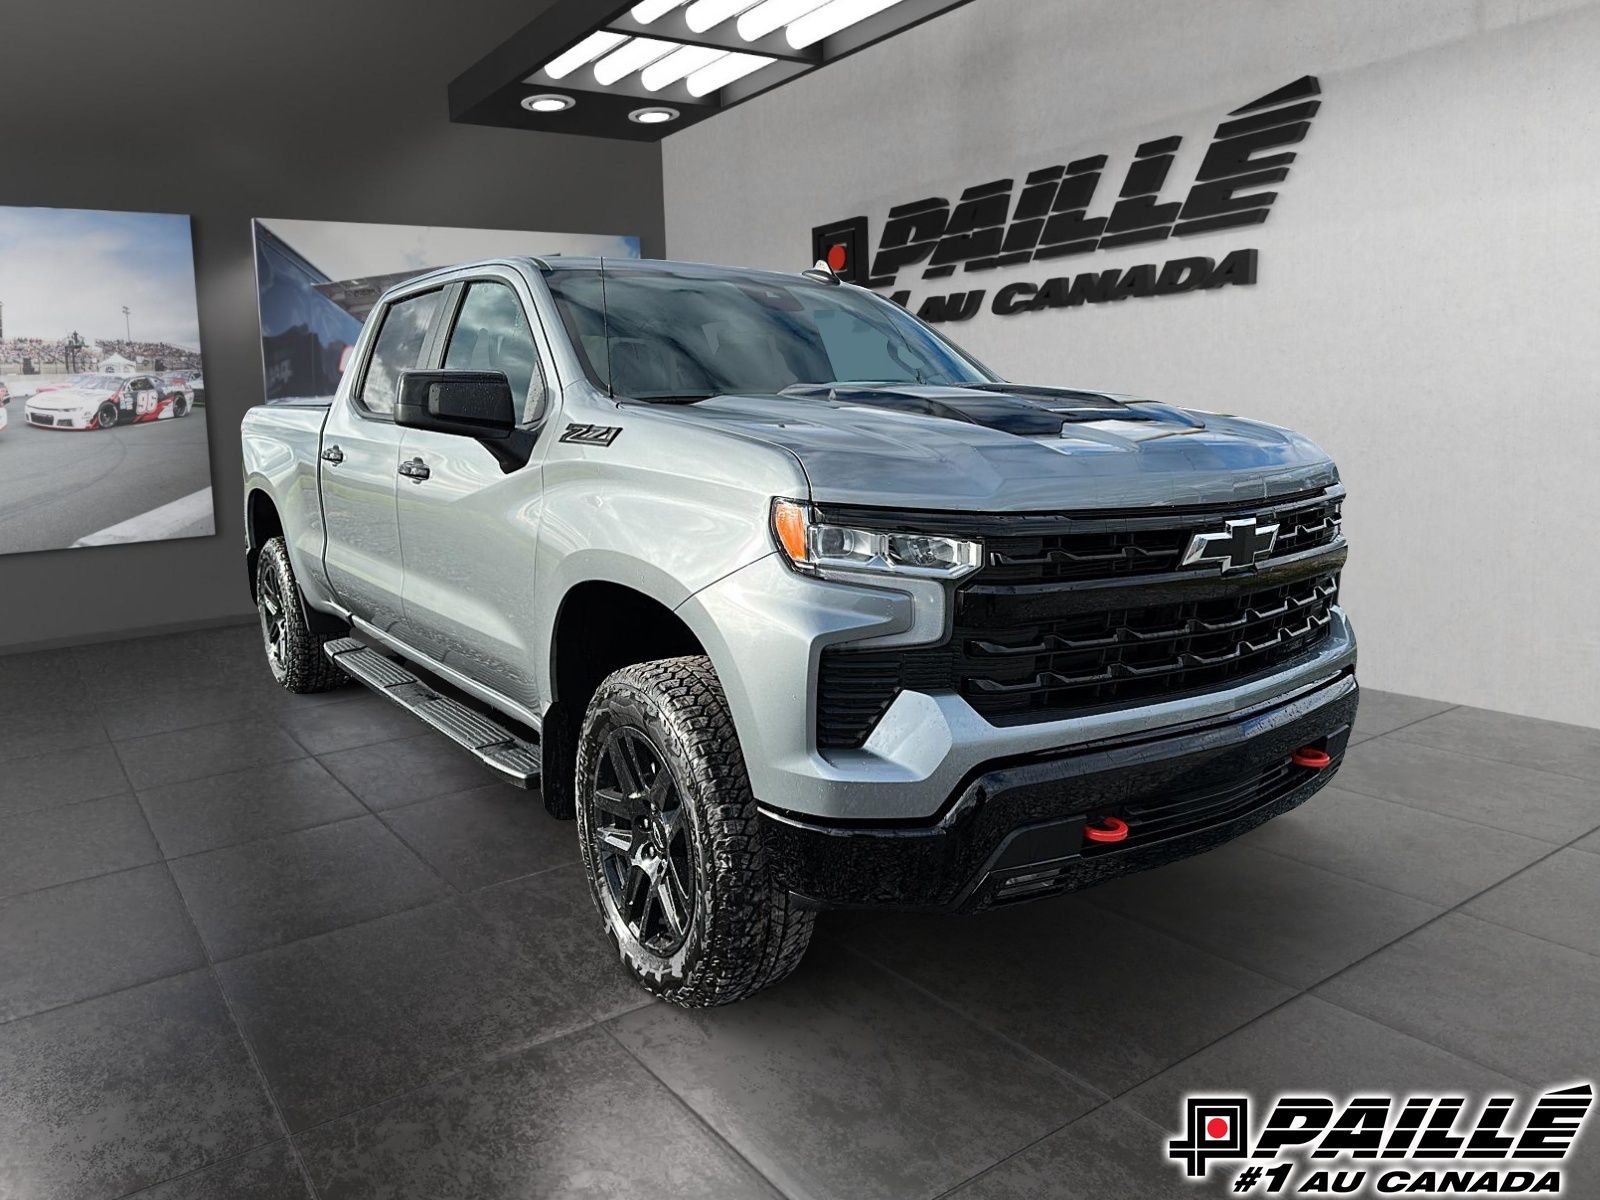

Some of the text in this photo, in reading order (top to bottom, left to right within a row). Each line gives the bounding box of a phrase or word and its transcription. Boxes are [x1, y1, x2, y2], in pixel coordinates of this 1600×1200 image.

[868, 75, 1322, 288] PAILLÉ
[917, 248, 1258, 323] AU CANADA
[136, 389, 159, 416] 96
